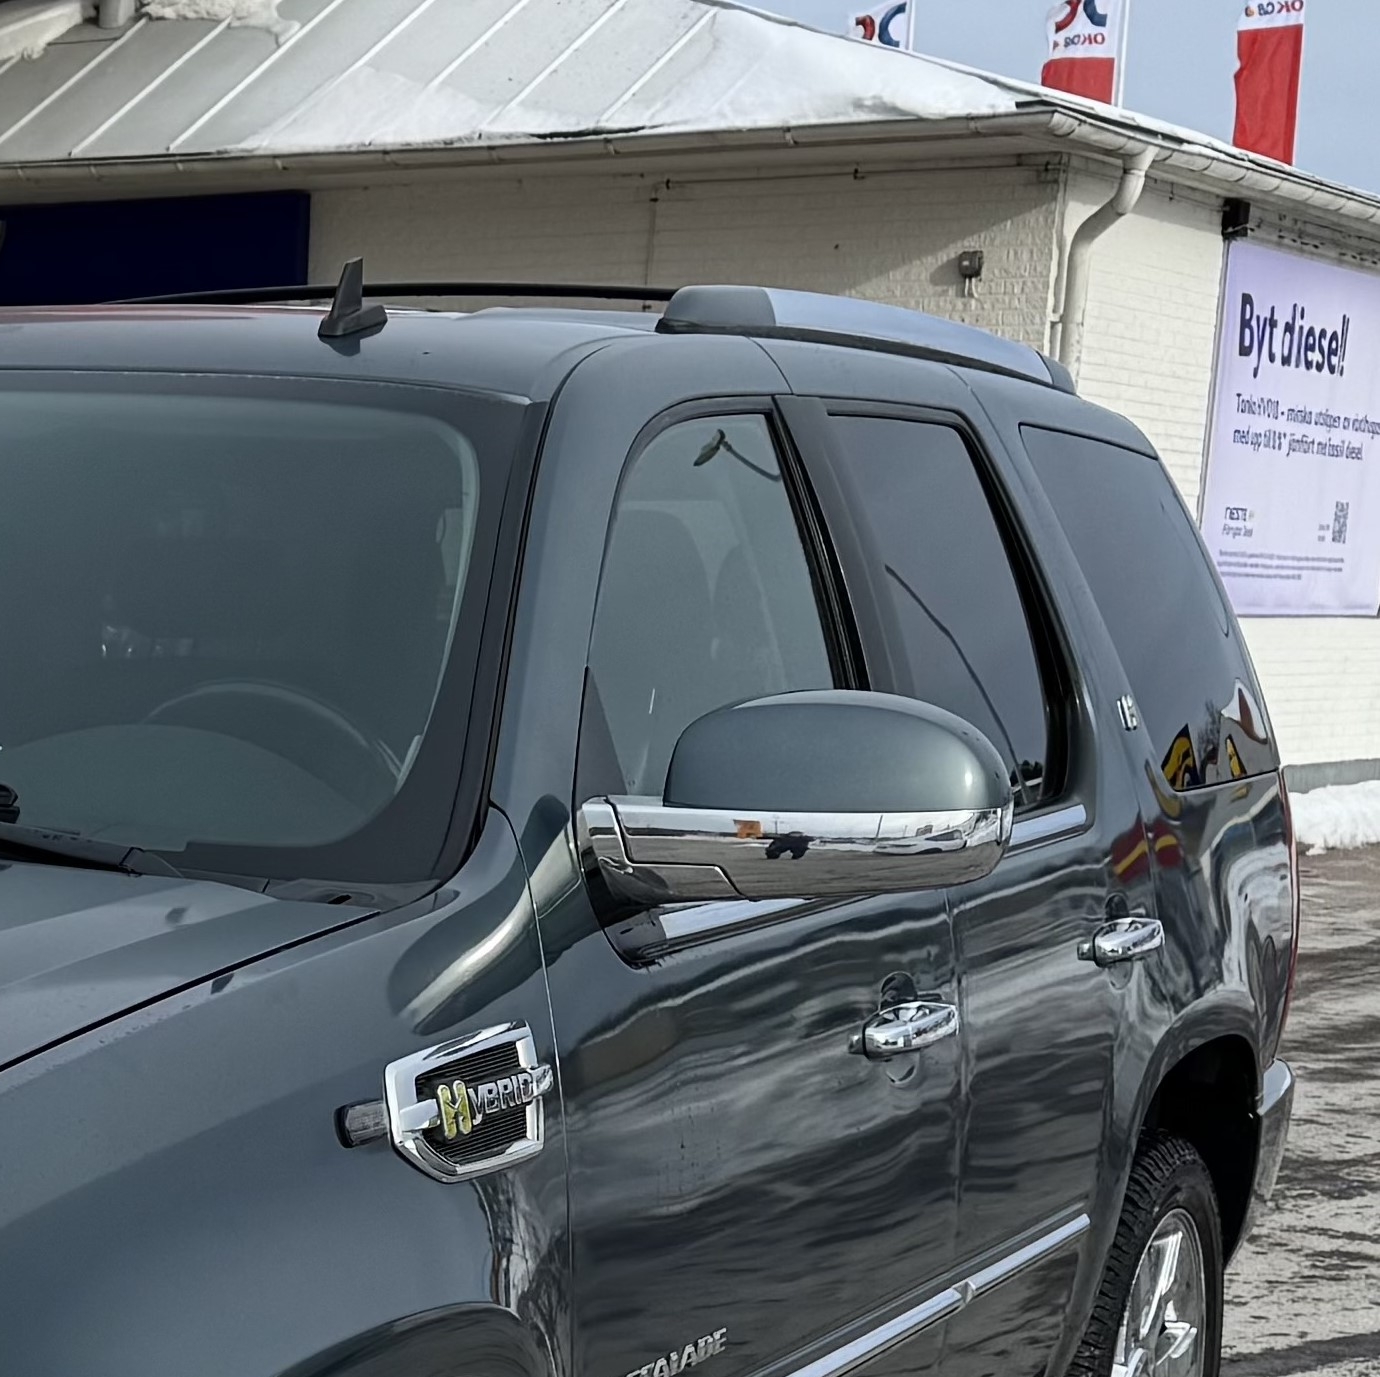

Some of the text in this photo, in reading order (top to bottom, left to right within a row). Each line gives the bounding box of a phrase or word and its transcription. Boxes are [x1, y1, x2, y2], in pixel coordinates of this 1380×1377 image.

[1239, 292, 1350, 379] Byt diesel!
[436, 1072, 535, 1139] HYBRID
